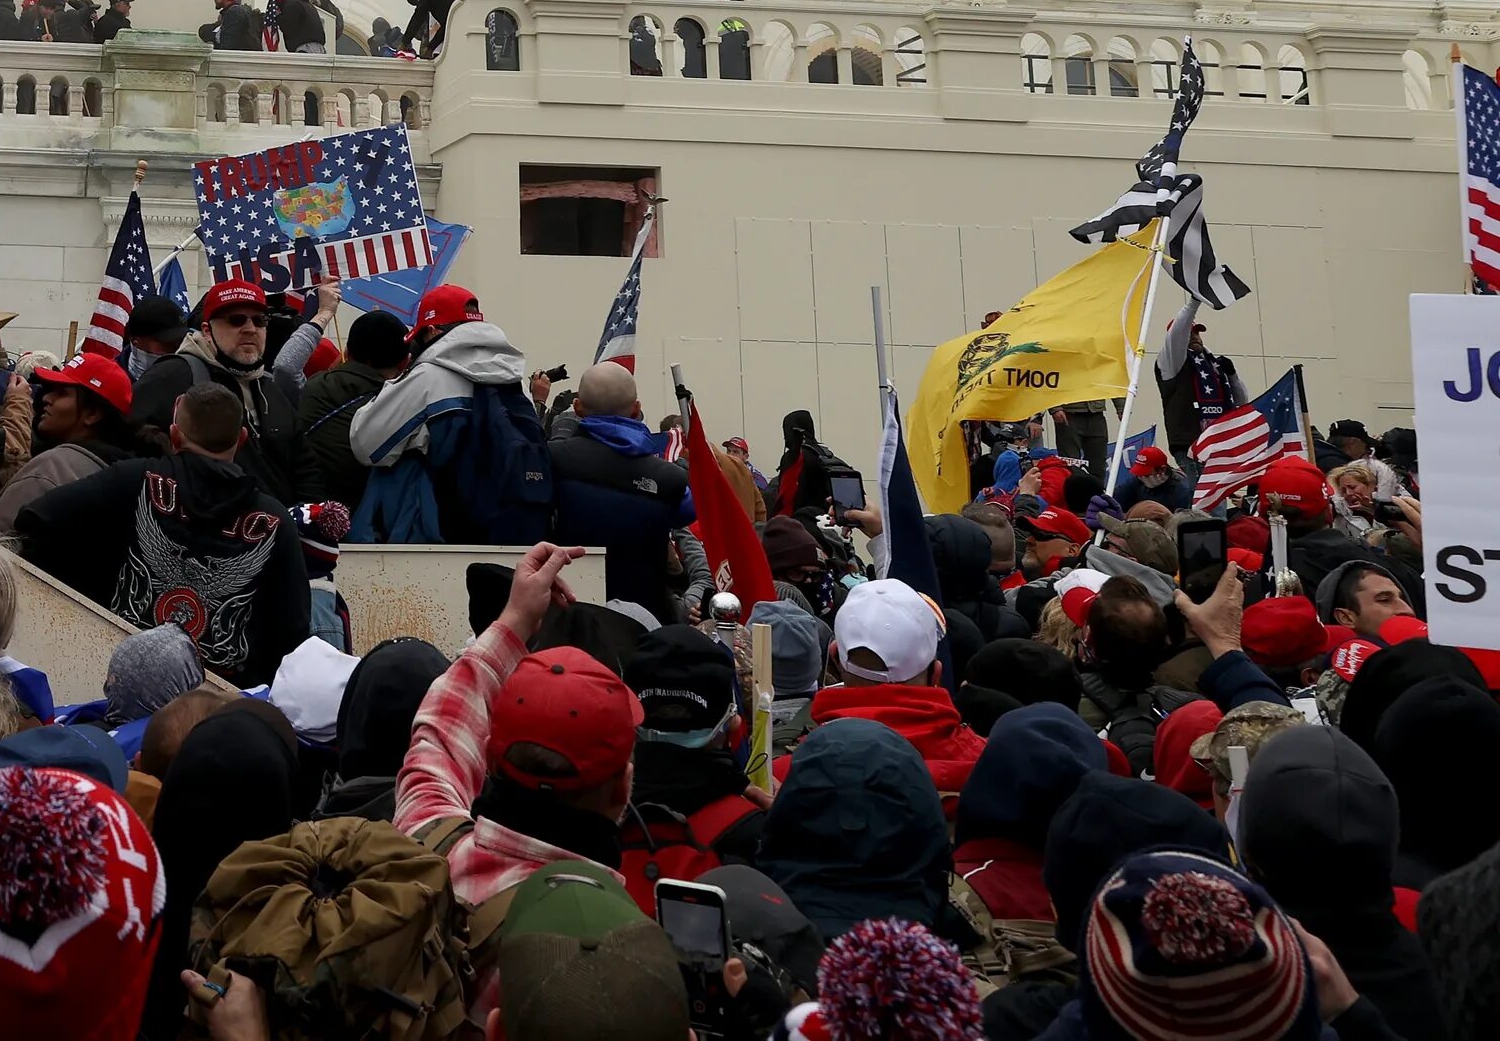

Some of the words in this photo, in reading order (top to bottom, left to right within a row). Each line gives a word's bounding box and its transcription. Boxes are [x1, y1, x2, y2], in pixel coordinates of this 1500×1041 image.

[196, 140, 325, 205] TRUMP
[212, 236, 322, 294] USA
[218, 289, 233, 297] MAKE
[233, 287, 257, 296] AMERICA
[221, 293, 238, 302] GREAT
[239, 293, 255, 301] AGAIN
[1201, 406, 1222, 414] 2020
[654, 687, 708, 709] INAUGURATION
